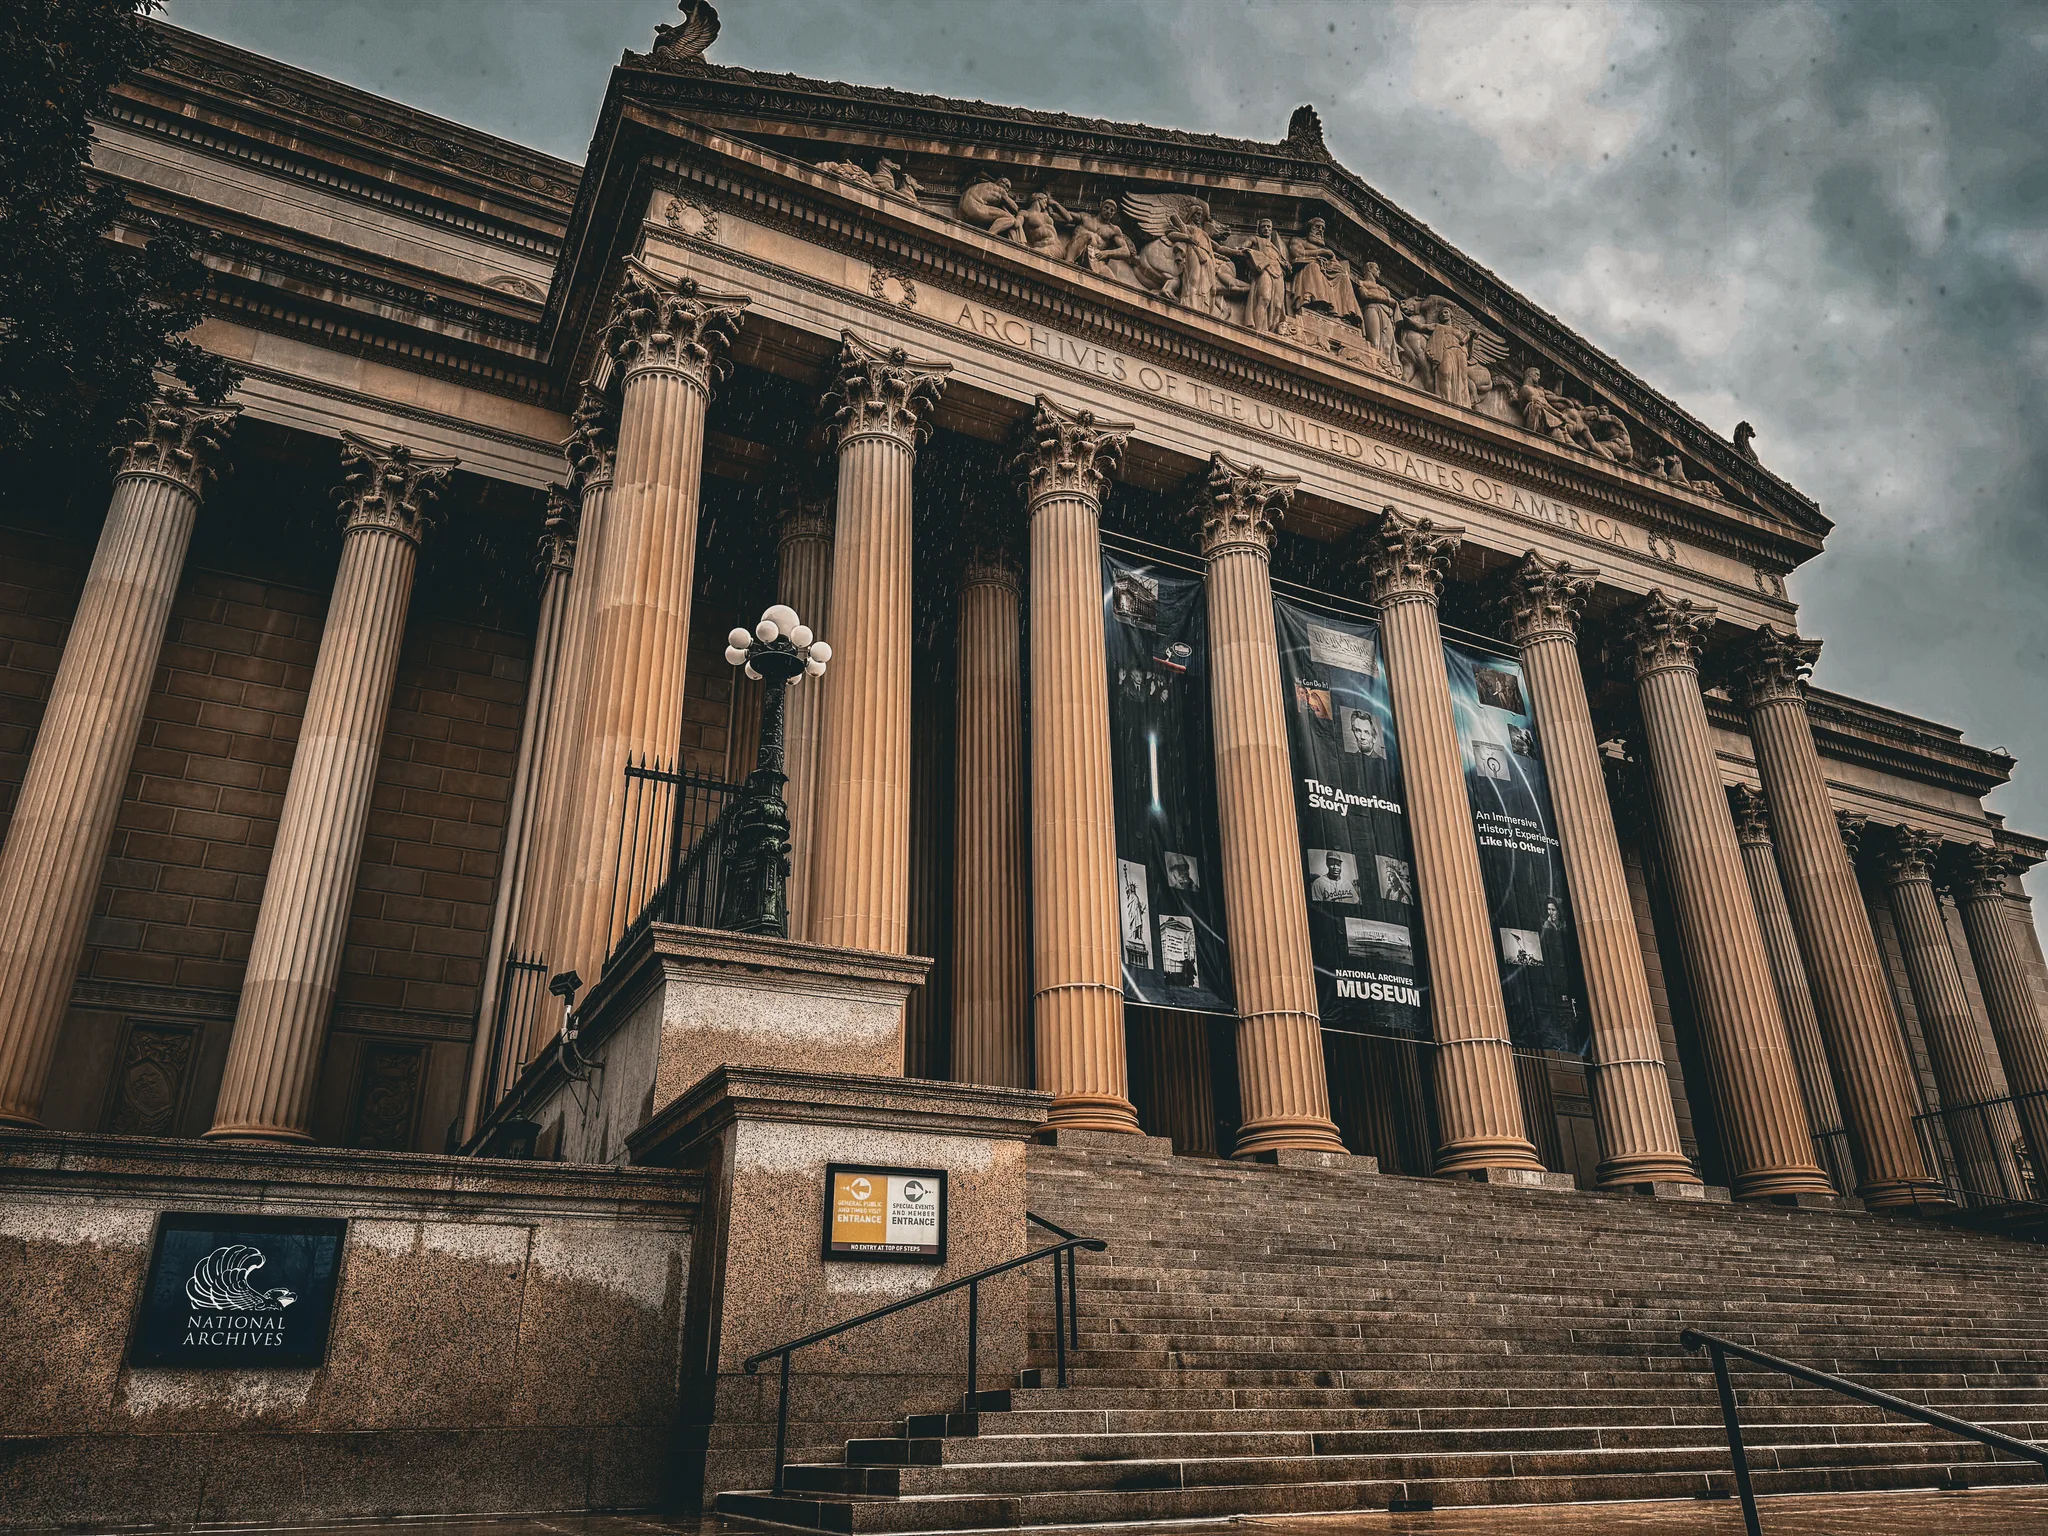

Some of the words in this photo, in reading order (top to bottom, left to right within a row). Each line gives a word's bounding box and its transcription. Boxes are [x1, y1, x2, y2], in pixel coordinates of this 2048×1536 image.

[957, 303, 1127, 381] ARCHIVES
[1139, 367, 1178, 399] OF
[1187, 382, 1246, 421] THE
[1254, 404, 1363, 459] UNITED
[1373, 444, 1465, 492] STATES
[1472, 478, 1503, 504] OF
[1513, 490, 1630, 547] AMERICA
[1304, 779, 1333, 796] The
[1335, 789, 1401, 814] American
[1309, 793, 1348, 816] Story
[1476, 811, 1490, 820] An
[1492, 812, 1538, 828] Immersive
[1478, 823, 1513, 838] History
[1515, 828, 1559, 847] Experience
[1480, 836, 1502, 847] Like
[1504, 838, 1518, 849] No
[1519, 841, 1546, 855] Other
[1335, 969, 1377, 980] NATIONAL
[1377, 973, 1413, 986] ARCHIVES
[1336, 979, 1420, 1007] MUSEUM
[837, 1214, 882, 1223] ENTRANCE
[892, 1217, 935, 1226] ENTRANCE
[187, 1315, 286, 1330] NATIONAL
[182, 1332, 284, 1346] ARCHIVES
